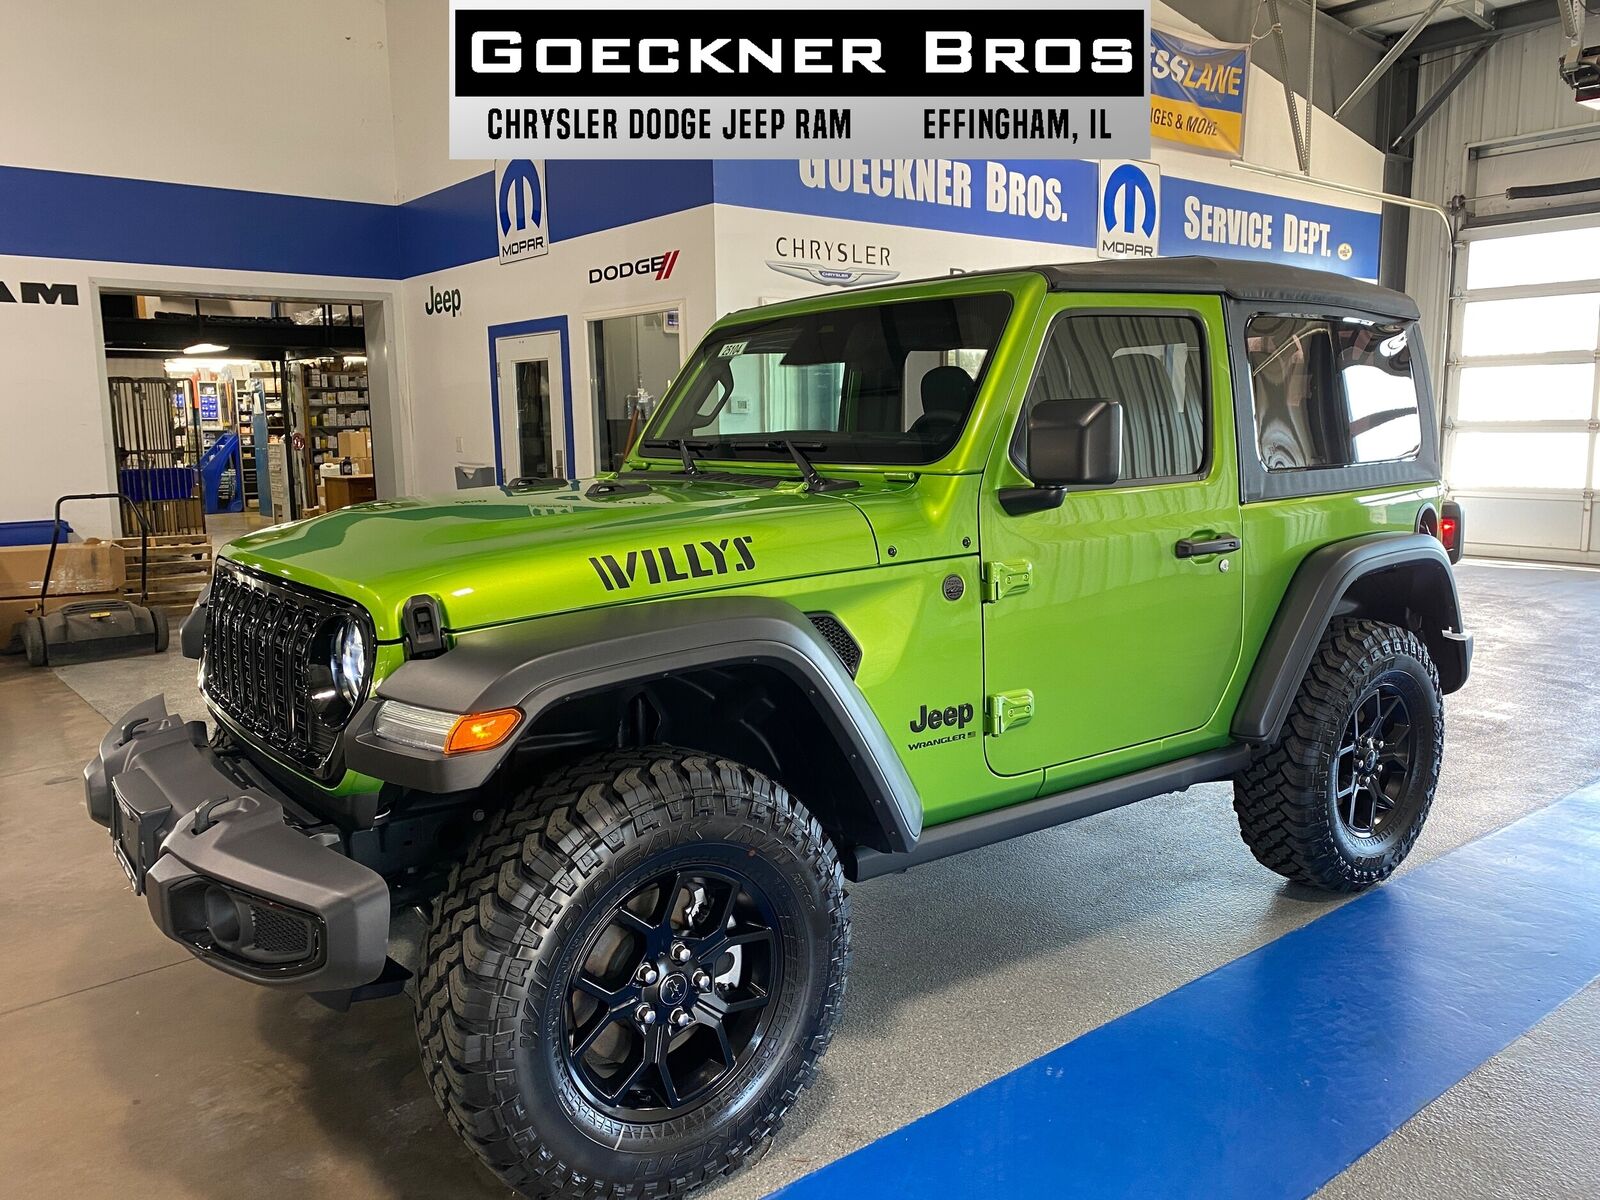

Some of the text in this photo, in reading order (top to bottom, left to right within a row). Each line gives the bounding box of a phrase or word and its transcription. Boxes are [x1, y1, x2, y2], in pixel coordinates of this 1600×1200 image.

[1150, 46, 1242, 95] SSLANE
[1151, 108, 1217, 136] GES & MORE
[986, 161, 1068, 222] BROS.
[1184, 196, 1332, 257] SERVICE DEPT.
[502, 236, 544, 257] MOPAR
[775, 236, 890, 266] CHRYSLER
[1102, 239, 1153, 257] MOPAR
[589, 256, 664, 284] DODGE
[425, 286, 461, 317] Jeep
[588, 536, 756, 591] WILLYS
[909, 703, 974, 733] Jeep
[908, 733, 966, 751] WRANGLER
